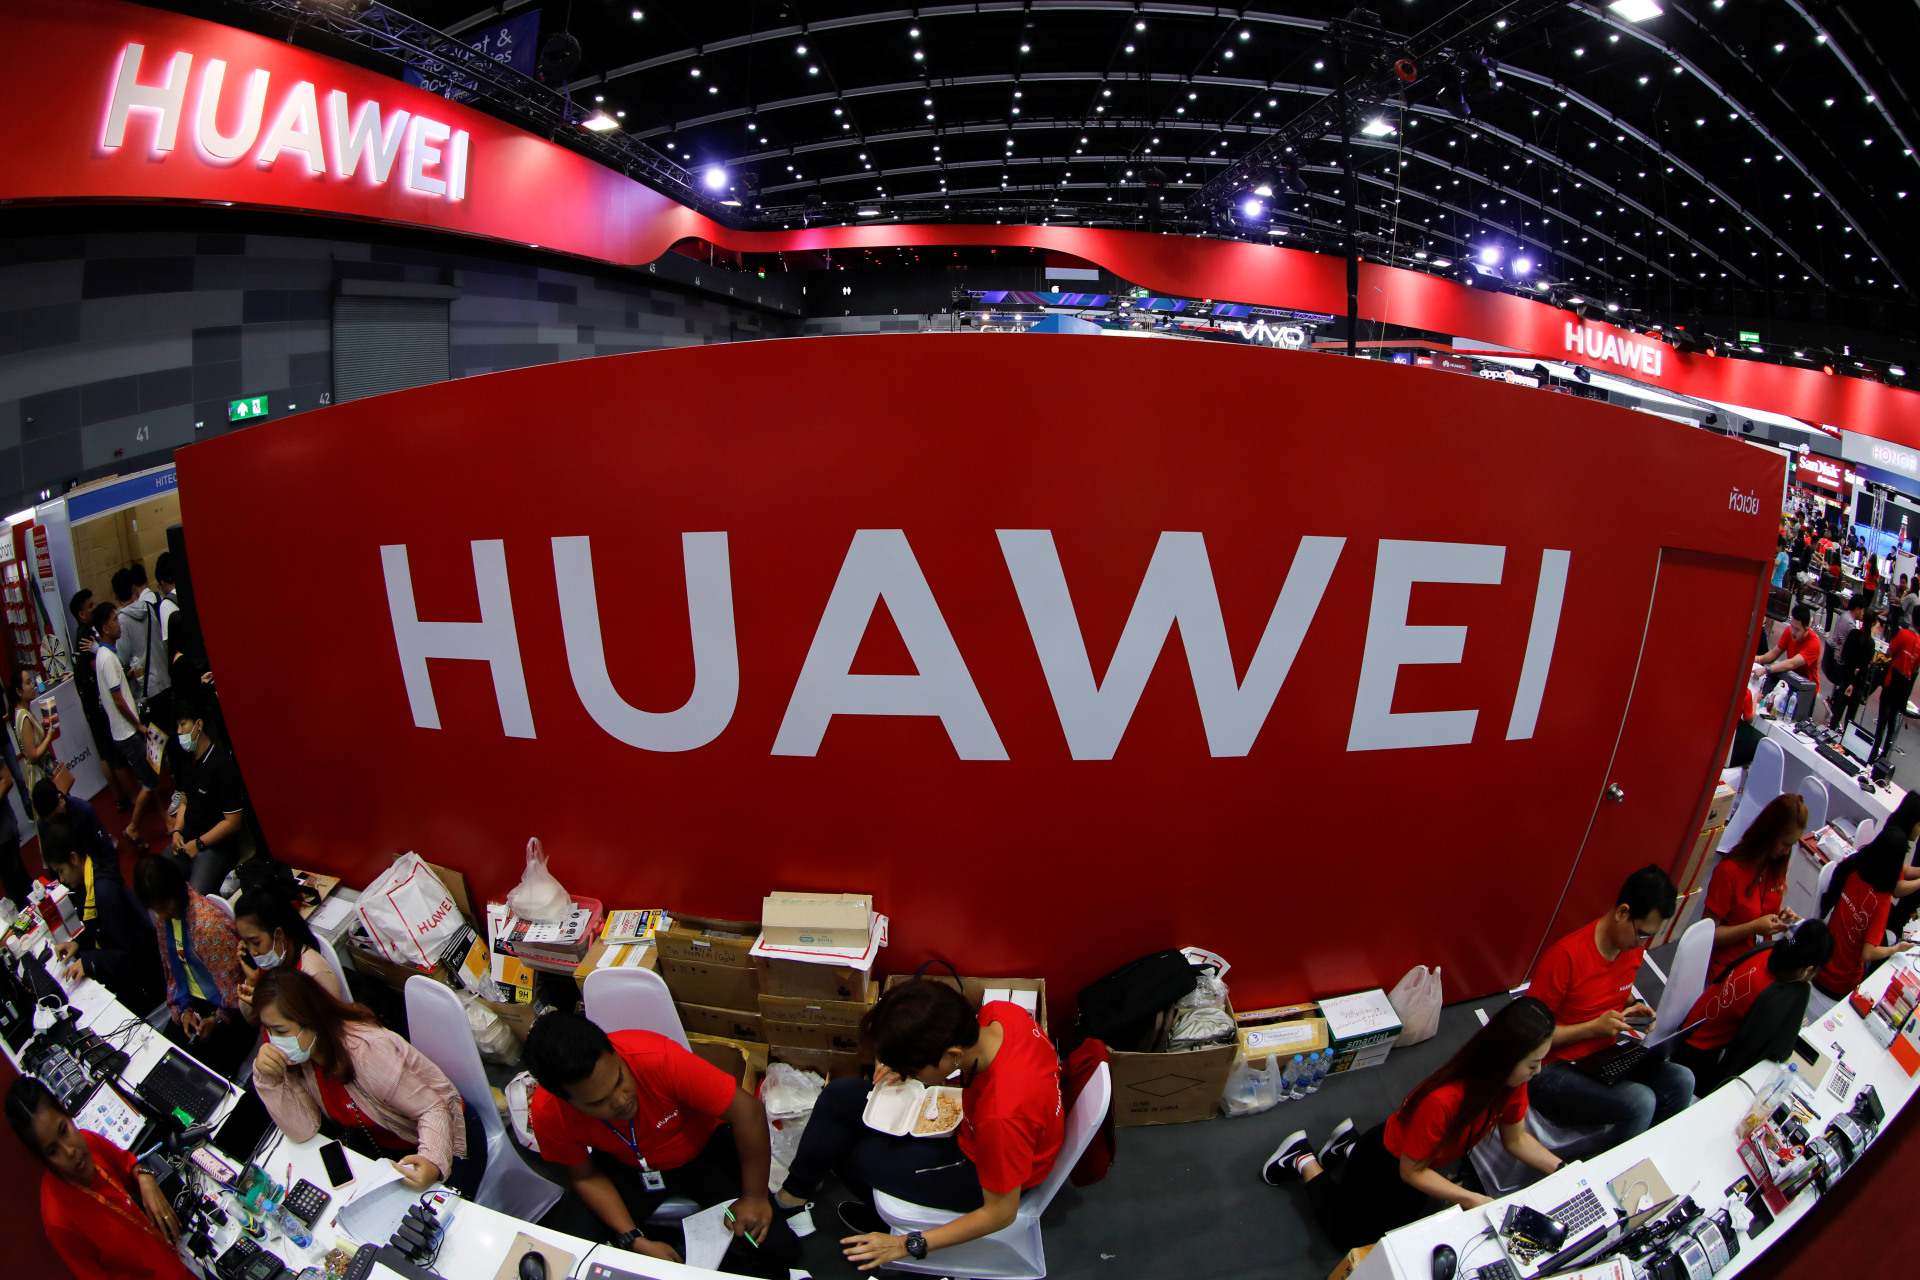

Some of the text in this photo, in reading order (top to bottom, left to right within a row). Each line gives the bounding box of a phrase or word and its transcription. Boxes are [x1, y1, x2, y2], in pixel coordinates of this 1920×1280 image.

[103, 43, 470, 200] HUAWEI
[1564, 321, 1662, 377] HUAWEI
[1479, 369, 1506, 379] oppo
[319, 393, 331, 405] 42
[136, 426, 149, 442] 41
[1799, 456, 1841, 479] SanDisk
[1872, 444, 1918, 472] HONOR
[1729, 486, 1760, 515] หัวเว่ย
[380, 529, 1571, 762] HUAWEI
[417, 896, 454, 935] HUAWEI
[518, 989, 530, 999] 9H
[1345, 1031, 1390, 1050] smartist
